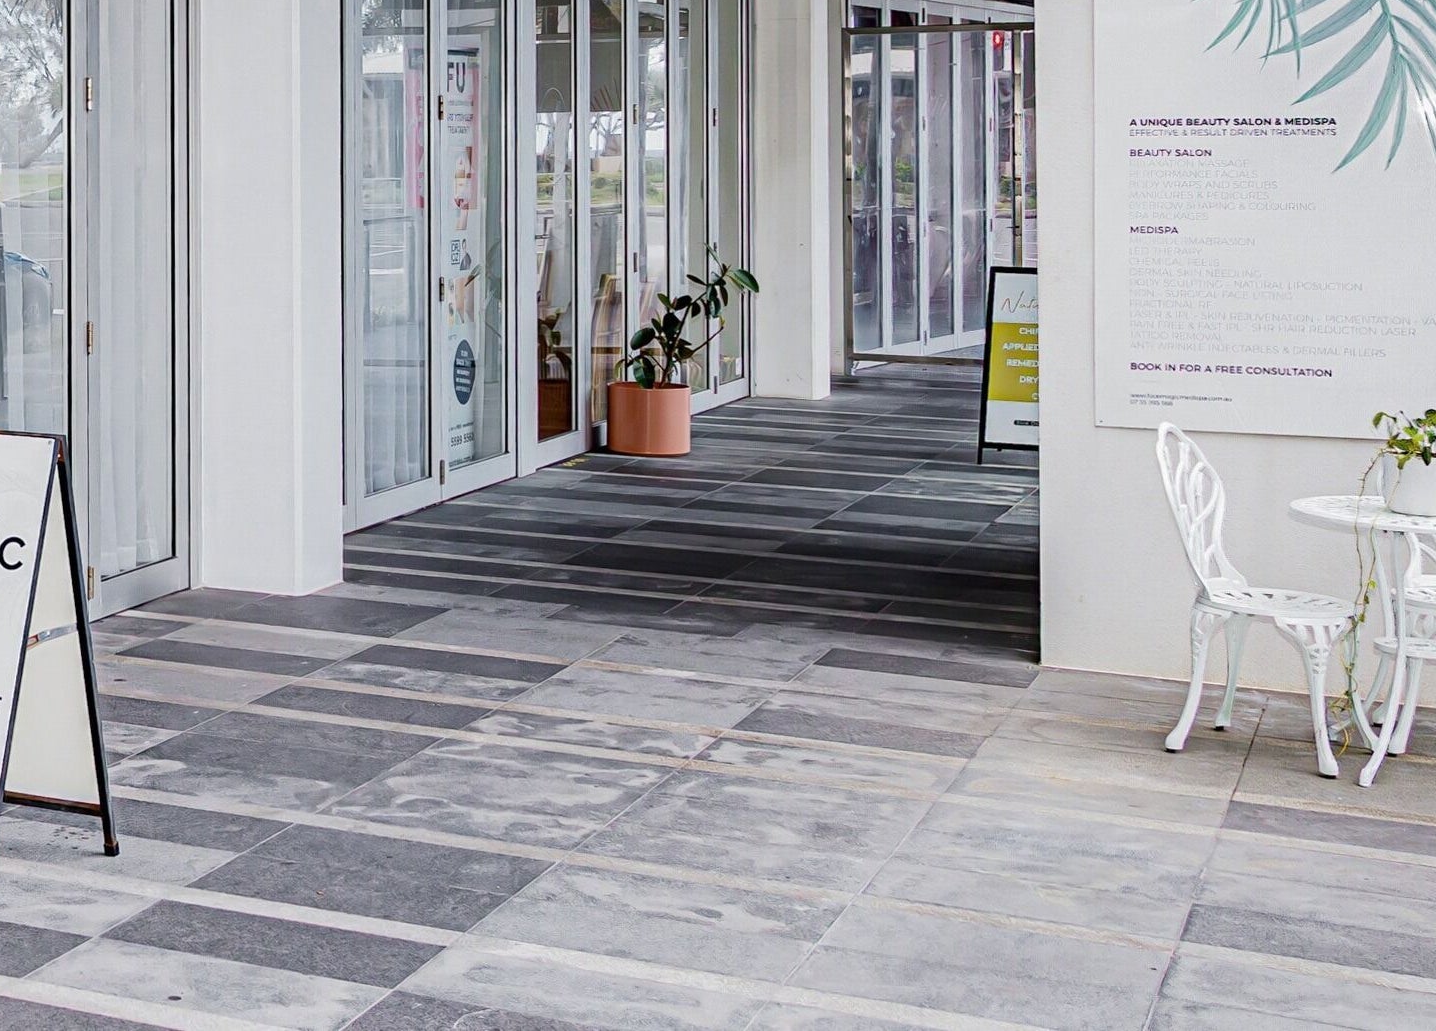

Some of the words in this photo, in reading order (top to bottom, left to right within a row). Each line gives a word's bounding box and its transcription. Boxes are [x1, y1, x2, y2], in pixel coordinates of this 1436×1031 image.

[1130, 117, 1136, 125] A
[1140, 117, 1182, 125] UNIQUE
[1186, 117, 1229, 125] BEAUTY
[1233, 117, 1271, 125] SALON
[1275, 117, 1280, 125] &
[1284, 117, 1336, 125] MEDISPA
[1130, 226, 1178, 234] MEDISPA
[1130, 362, 1161, 370] BOOK
[1165, 363, 1175, 371] IN
[1179, 364, 1200, 372] FOR
[1215, 365, 1242, 374] FREE
[1246, 366, 1331, 377] CONSULTATION
